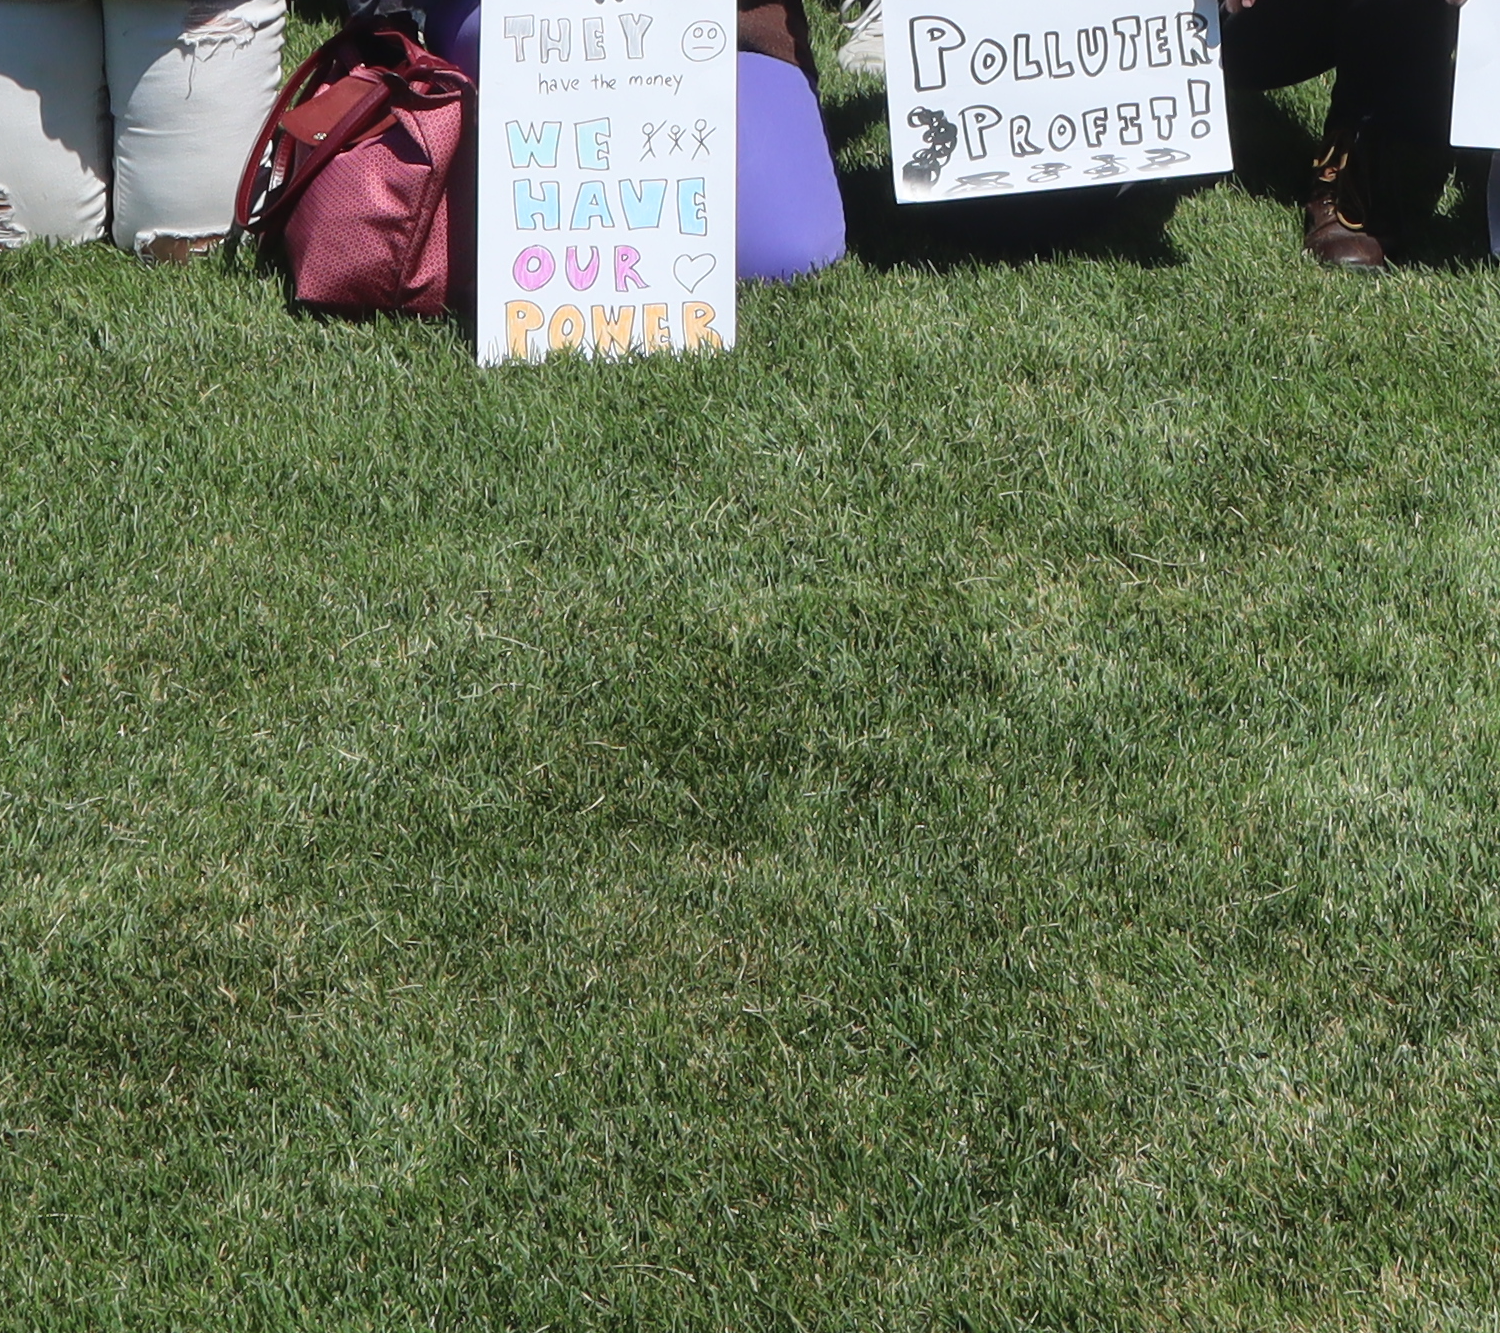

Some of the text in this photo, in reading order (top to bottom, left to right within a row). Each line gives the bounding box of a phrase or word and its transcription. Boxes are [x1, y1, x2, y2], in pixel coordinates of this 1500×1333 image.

[503, 13, 653, 64] THEY
[538, 71, 684, 96] have the money
[505, 117, 612, 171] WE
[512, 177, 708, 237] HAVE
[512, 244, 650, 293] OUR
[504, 299, 727, 360] POWER
